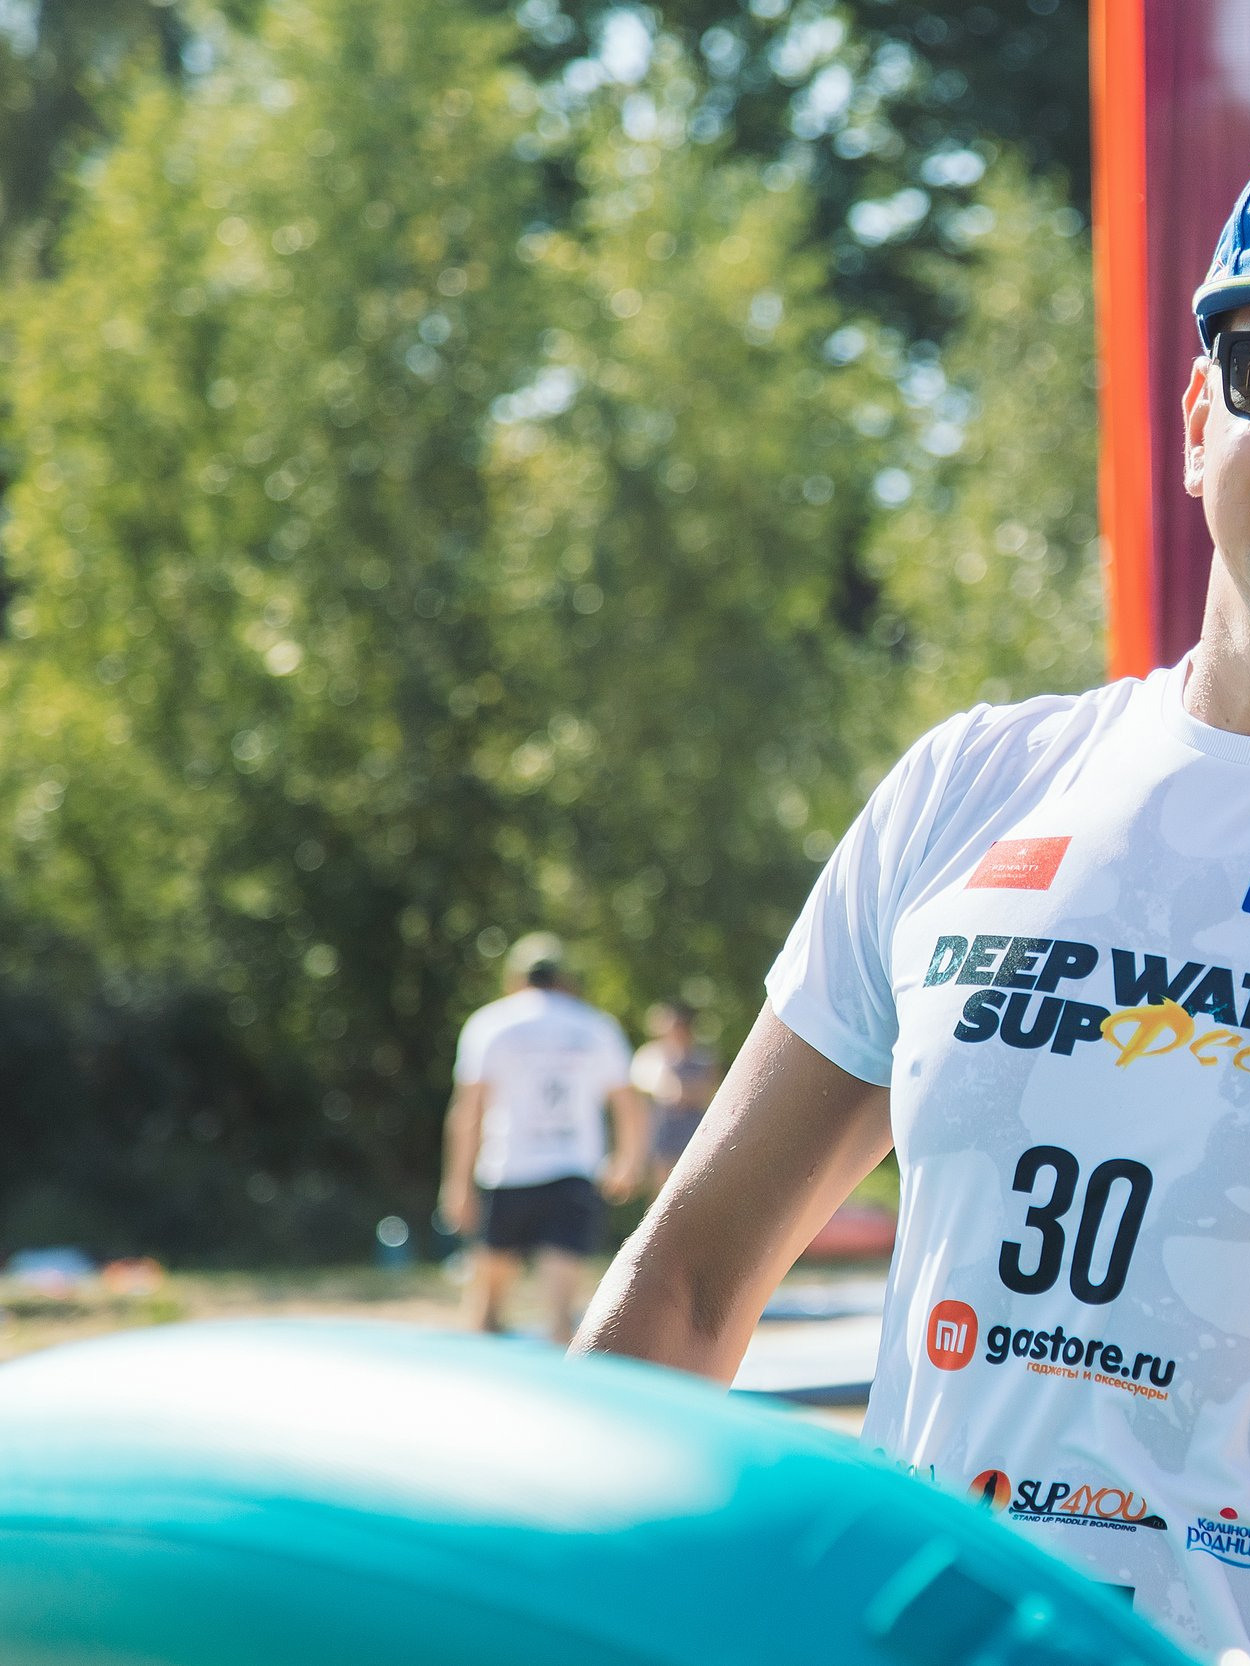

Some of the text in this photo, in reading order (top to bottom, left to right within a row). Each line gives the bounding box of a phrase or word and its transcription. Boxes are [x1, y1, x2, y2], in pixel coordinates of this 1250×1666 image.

[923, 934, 1099, 993] DEEP
[998, 1144, 1154, 1306] 30
[985, 1325, 1176, 1388] gastore.ru
[1026, 1361, 1169, 1401] гаджеты и аксессуары
[1012, 1513, 1041, 1522] STAND
[1054, 1517, 1088, 1527] PADDLE
[1089, 1520, 1137, 1533] BOARDING
[1013, 1479, 1147, 1521] SUP4YOU
